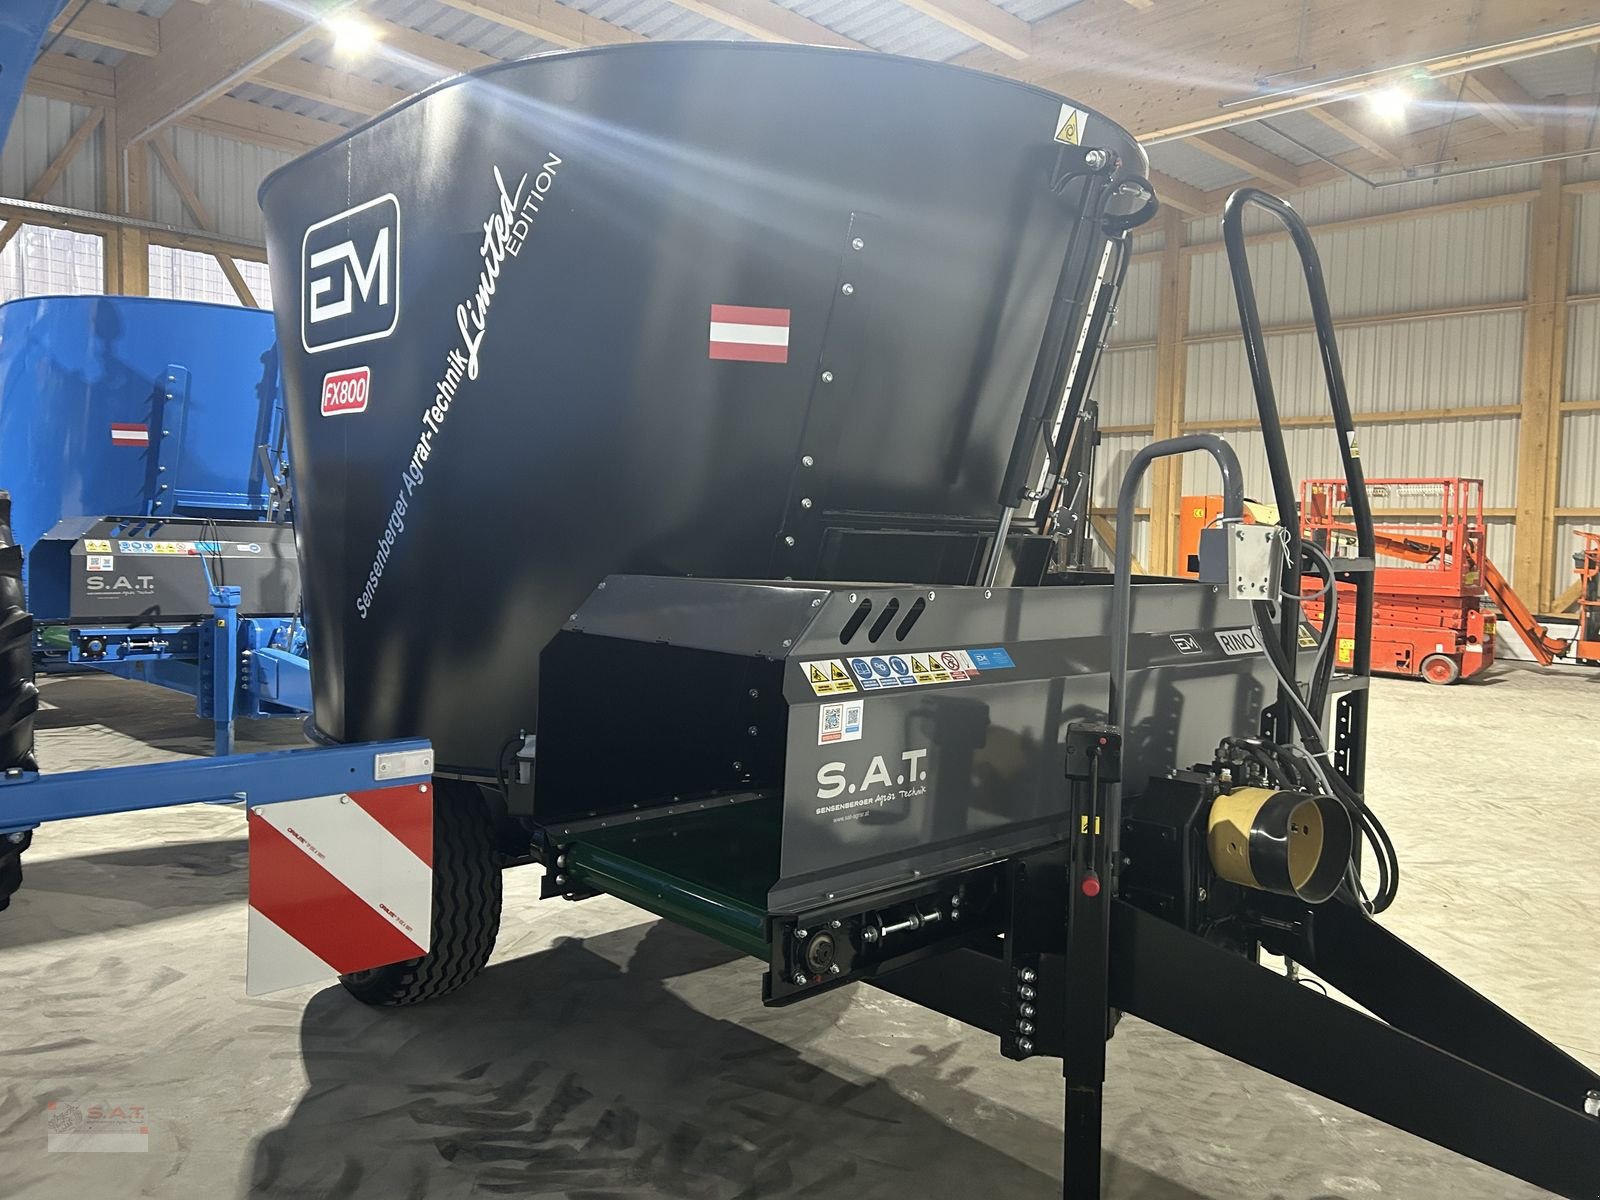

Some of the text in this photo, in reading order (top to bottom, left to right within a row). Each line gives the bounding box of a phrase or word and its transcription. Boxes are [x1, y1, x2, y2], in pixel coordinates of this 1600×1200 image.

[505, 152, 563, 257] EDITION
[310, 227, 389, 323] EM
[455, 165, 529, 381] Limited
[324, 377, 366, 407] FX800
[354, 348, 469, 620] Sensenberger Agrar-Technik
[86, 576, 154, 590] S.A.T.
[815, 798, 873, 815] SENSENBERGER
[816, 748, 927, 799] S.A.T.
